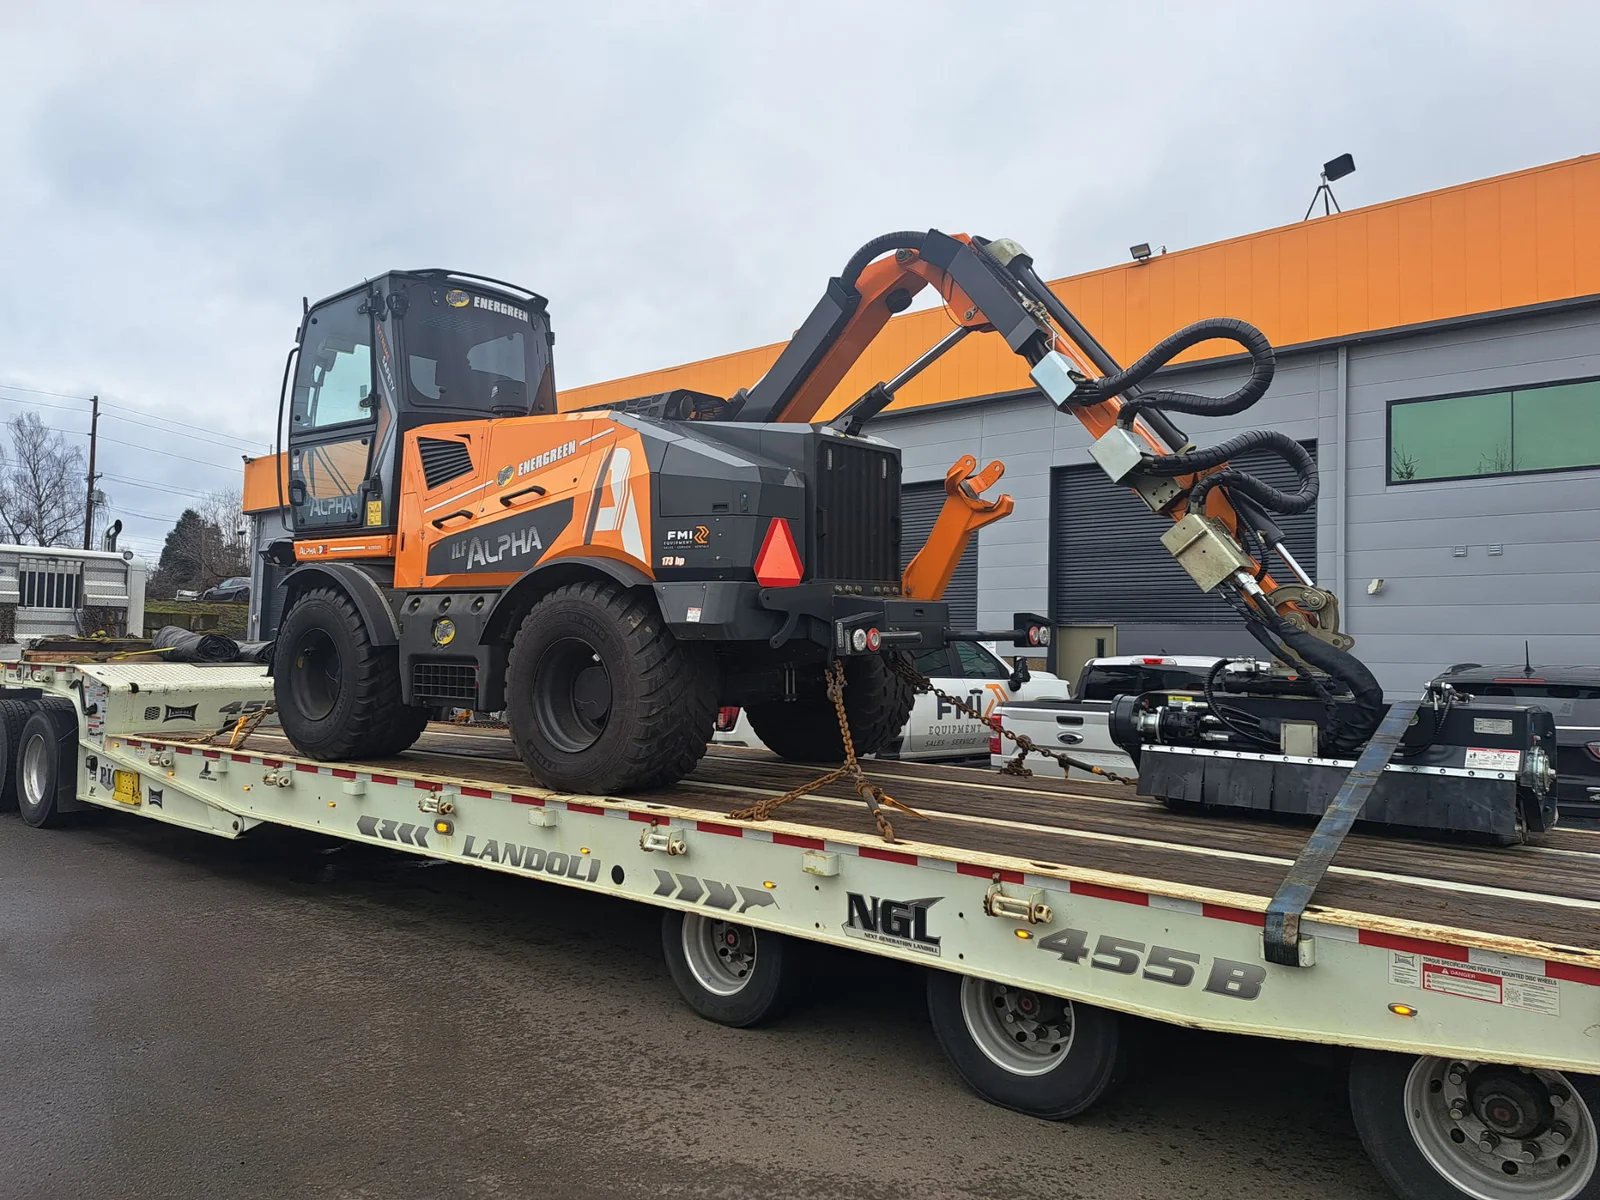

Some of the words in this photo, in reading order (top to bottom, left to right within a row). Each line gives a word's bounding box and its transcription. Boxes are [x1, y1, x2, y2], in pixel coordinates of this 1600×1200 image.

[473, 296, 529, 322] ENERGREEN
[382, 355, 396, 393] SAFETY
[518, 440, 576, 477] ENERGREEN
[309, 496, 353, 517] ALPHA
[668, 530, 693, 540] FMI
[466, 525, 543, 570] ALPHA
[662, 556, 674, 566] 173
[675, 556, 685, 566] hp
[936, 695, 982, 721] FMI
[925, 740, 946, 748] SALES
[951, 737, 977, 746] SERVICE
[928, 724, 983, 737] EQUIPMENT
[845, 890, 942, 946] NGL
[863, 932, 879, 941] NEXT
[878, 935, 912, 948] GENERATION
[912, 943, 939, 954] LANDOLL
[1422, 956, 1441, 965] TORQUE
[1441, 960, 1477, 971] SPECIFICATIONS
[1487, 968, 1501, 976] PILOT
[1501, 970, 1525, 980] MOUNTED
[1524, 974, 1537, 982] DISC
[1536, 977, 1557, 986] WHEELS
[1450, 970, 1476, 979] DANGER
